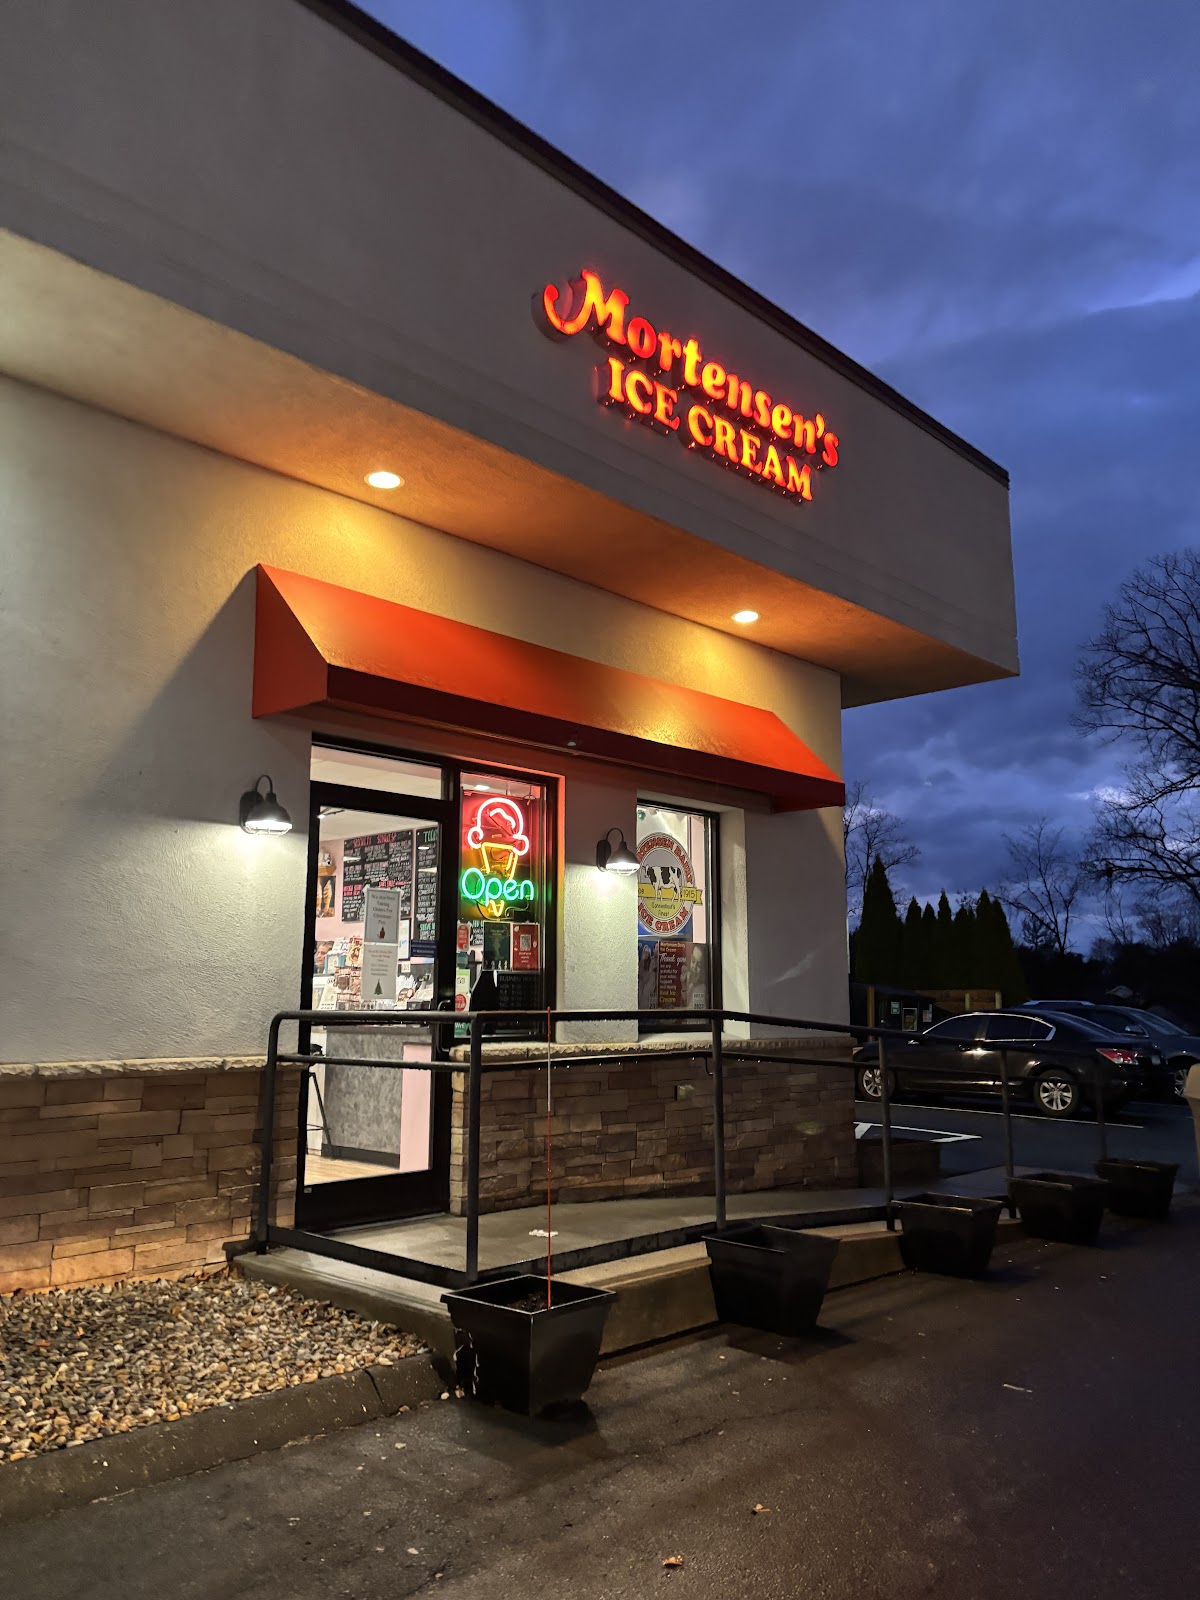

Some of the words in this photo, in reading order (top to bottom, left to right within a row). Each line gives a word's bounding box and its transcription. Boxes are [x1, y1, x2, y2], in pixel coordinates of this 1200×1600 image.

[544, 269, 839, 468] Mortensen's
[607, 356, 680, 430] ICE
[688, 404, 813, 501] CREAM
[674, 845, 693, 884] DAIRY
[462, 868, 534, 906] Open
[683, 889, 696, 899] 1915
[637, 902, 654, 926] ICE
[655, 906, 689, 931] CREAM
[659, 953, 676, 963] Thank
